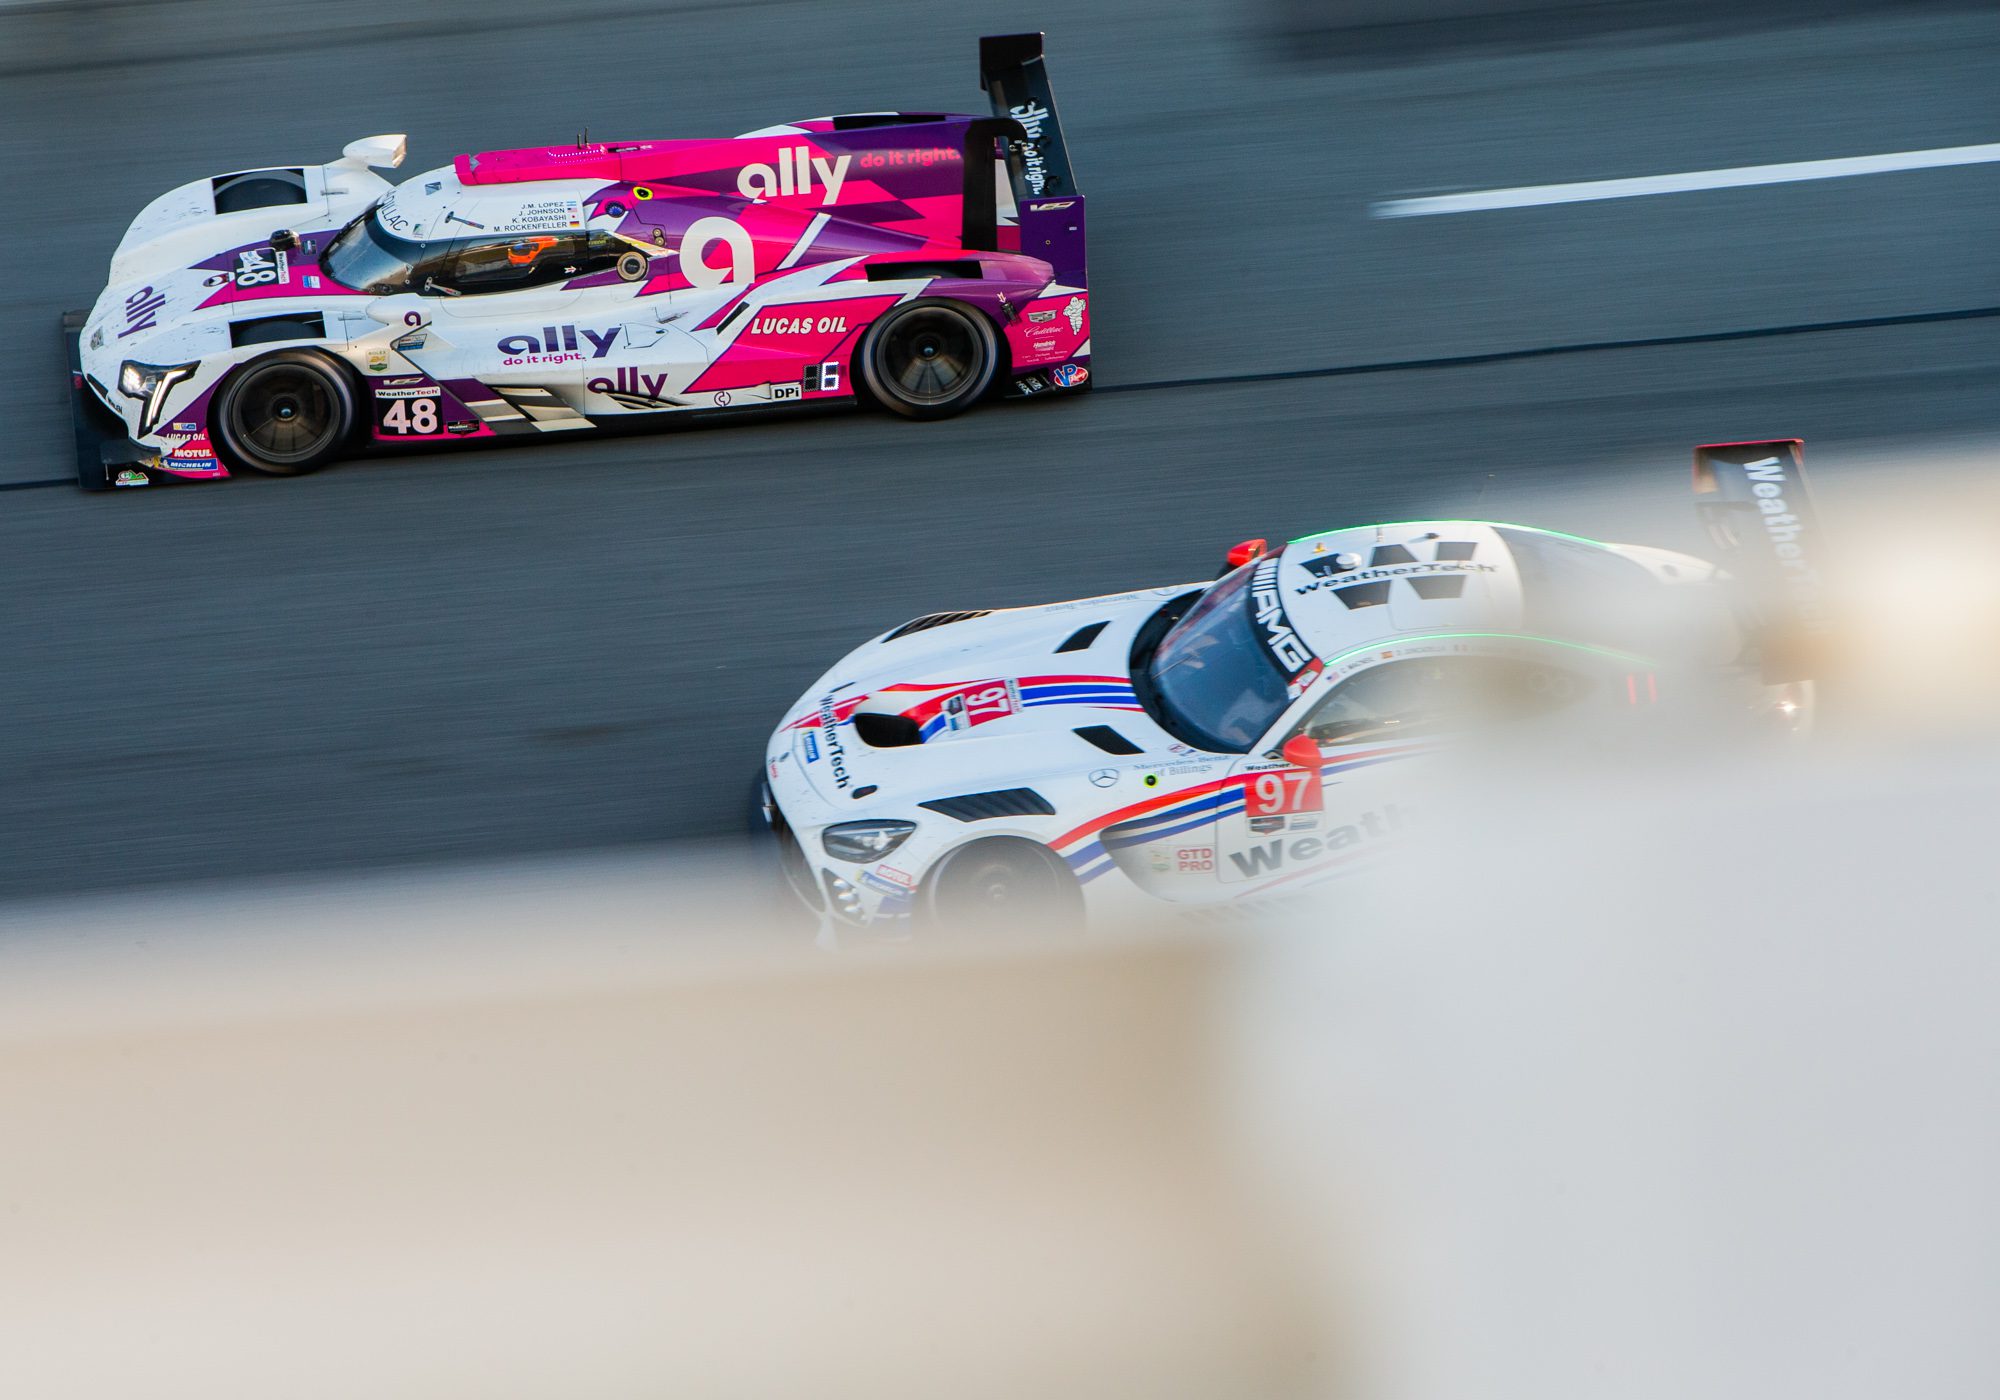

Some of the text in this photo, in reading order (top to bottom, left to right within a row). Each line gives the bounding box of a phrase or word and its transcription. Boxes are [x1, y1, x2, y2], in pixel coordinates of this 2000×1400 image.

[736, 146, 961, 206] ally do it right.
[527, 207, 565, 216] JOHNSON
[538, 201, 564, 209] LOPEZ
[504, 221, 567, 232] ROCKENFELLER
[521, 214, 567, 223] KOBAYASHI
[236, 250, 277, 287] 48
[117, 286, 166, 339] ally
[751, 316, 847, 335] LUCAS OIL
[1023, 325, 1064, 338] Cadillac
[497, 324, 622, 359] ally
[503, 352, 587, 366] do it right.
[587, 366, 668, 399] ally
[820, 361, 840, 392] 6
[1054, 364, 1077, 387] VP
[377, 388, 439, 397] WeatherTech
[774, 387, 799, 399] DPi
[382, 398, 438, 435] 48
[166, 433, 206, 441] LUCAS OIL
[173, 448, 212, 458] MOTUL
[1294, 563, 1498, 596] WeatherTech
[1253, 588, 1313, 673] AMG
[965, 687, 1011, 717] 97
[819, 694, 851, 790] WeatherTech
[1255, 771, 1313, 814] 97
[1178, 848, 1213, 860] GTD
[1178, 860, 1213, 871] PRO
